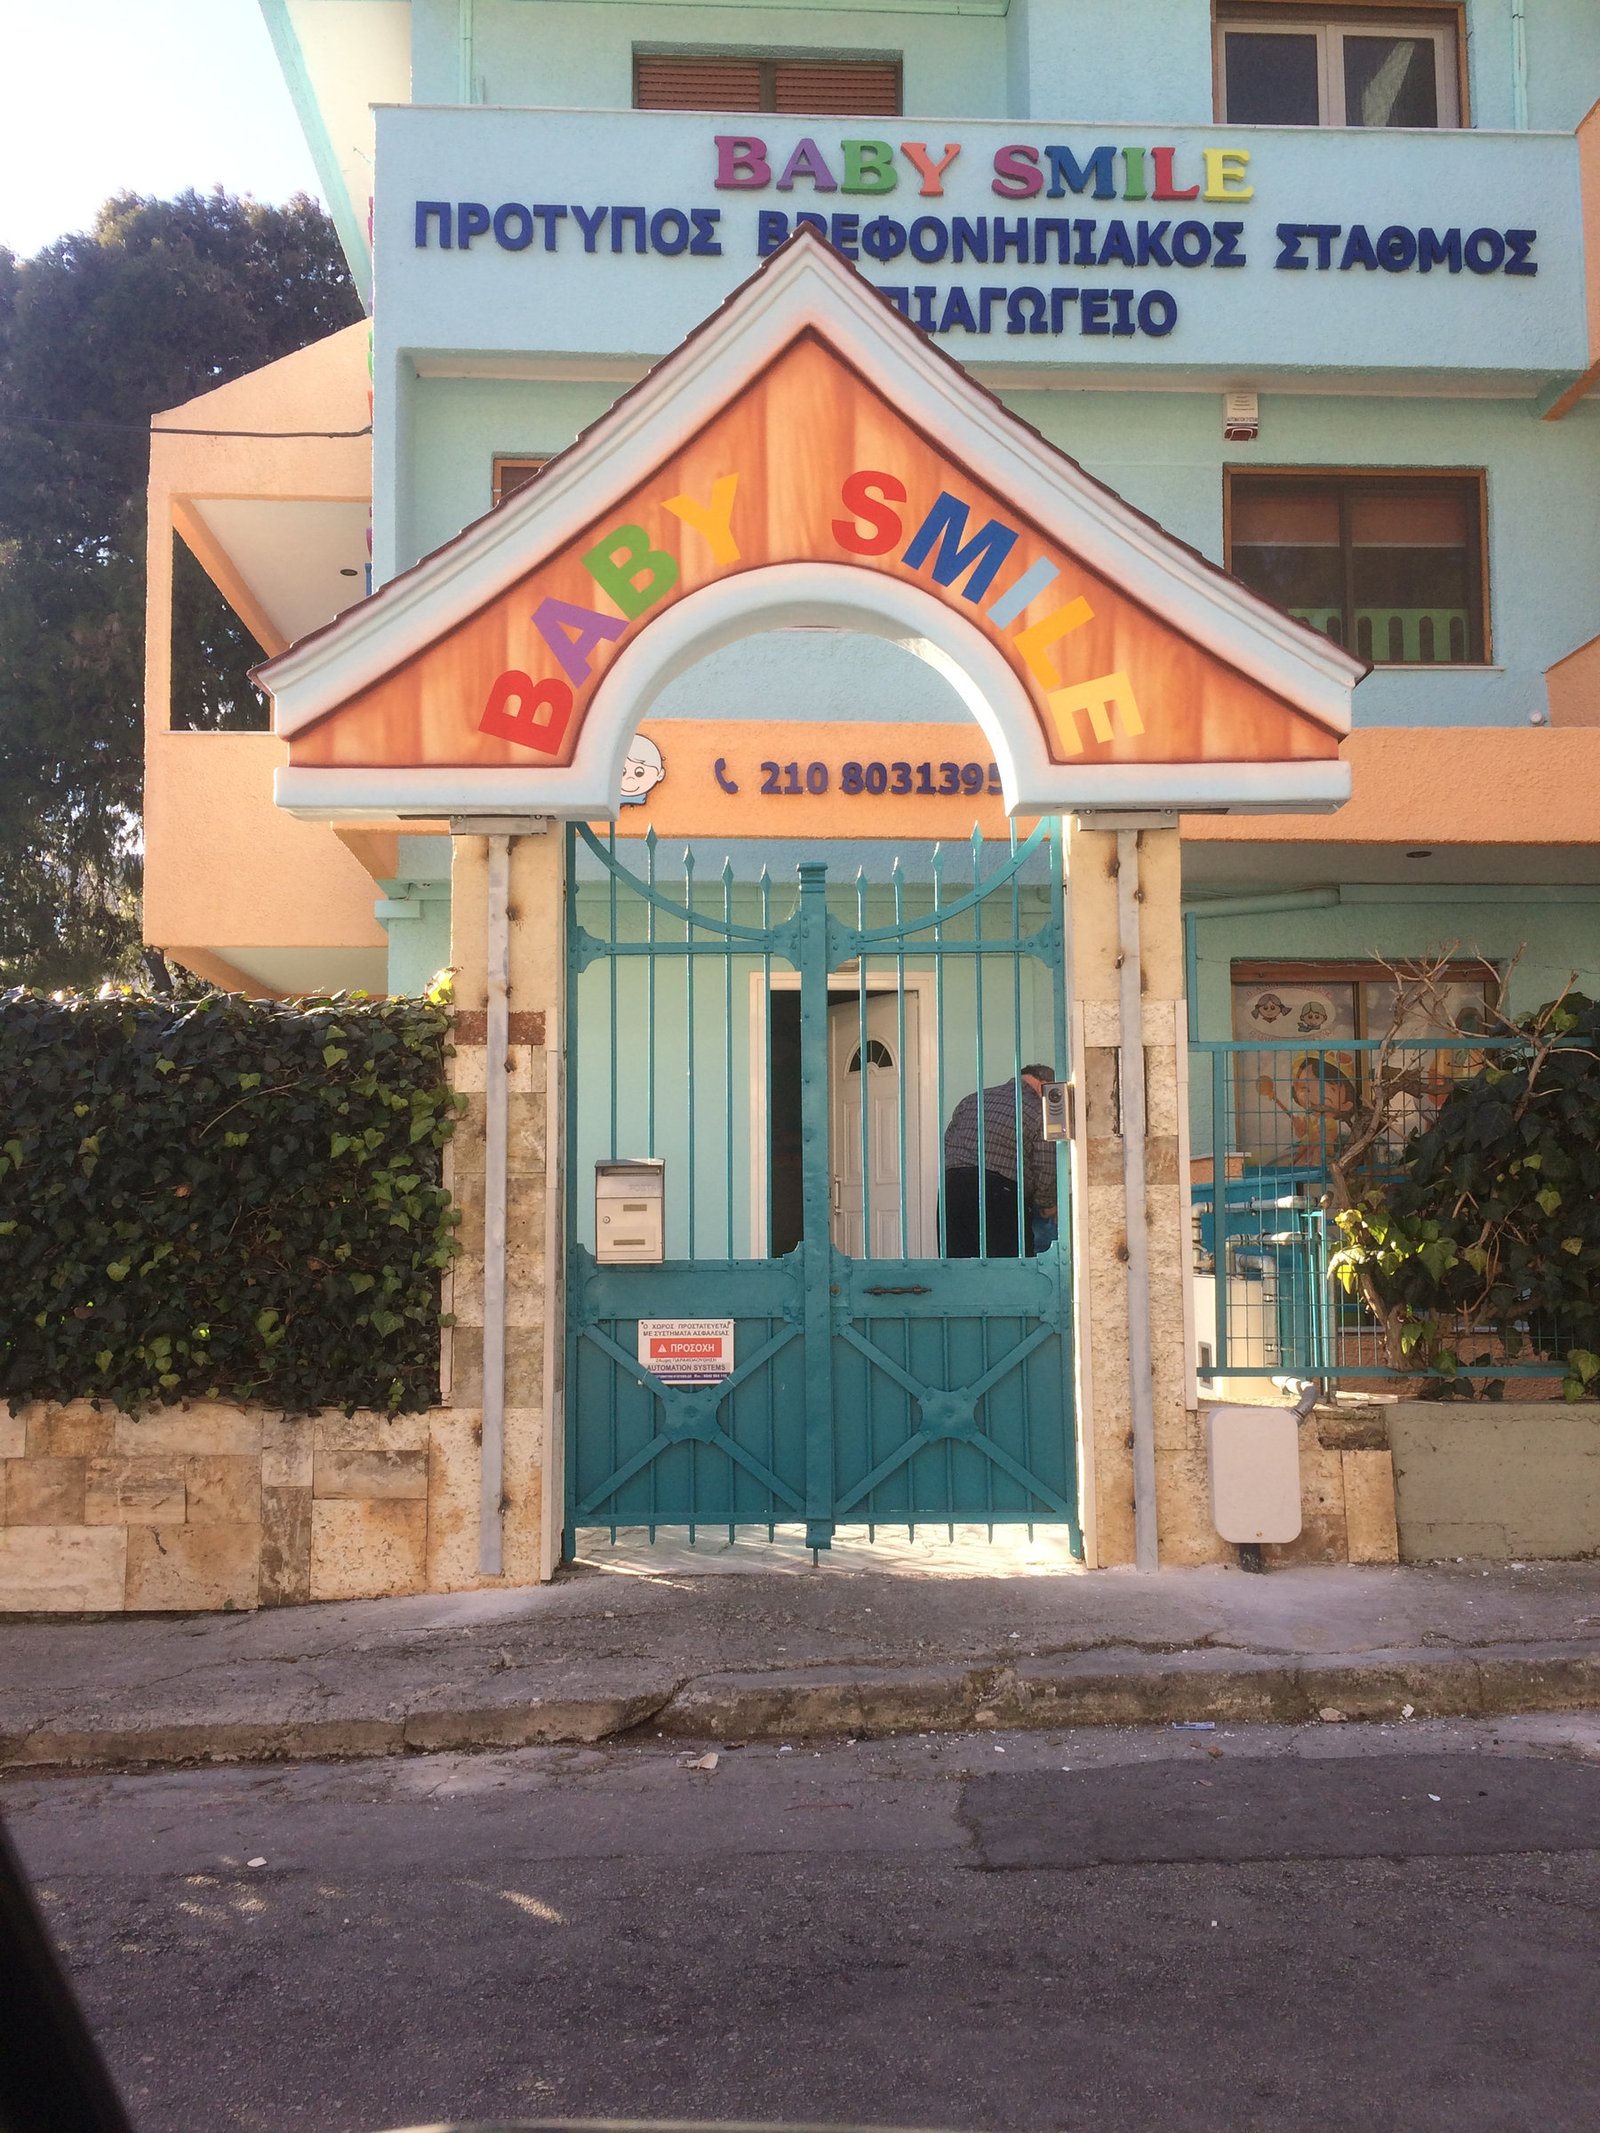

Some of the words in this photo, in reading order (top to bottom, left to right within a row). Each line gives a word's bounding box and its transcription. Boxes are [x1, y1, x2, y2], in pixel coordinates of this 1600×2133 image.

[713, 135, 962, 197] BABY
[991, 145, 1255, 201] SMILE
[414, 200, 723, 256] ΠΡΟΤΥΠΟΣ
[1274, 222, 1538, 275] ΣΤΑΘΜΟΣ
[477, 472, 742, 756] BABY
[831, 469, 1145, 757] SMILE
[760, 762, 829, 795] 210
[647, 1364, 692, 1372] AUTOMATION
[670, 1343, 715, 1353] ΠΡΟΣΟΧΗ
